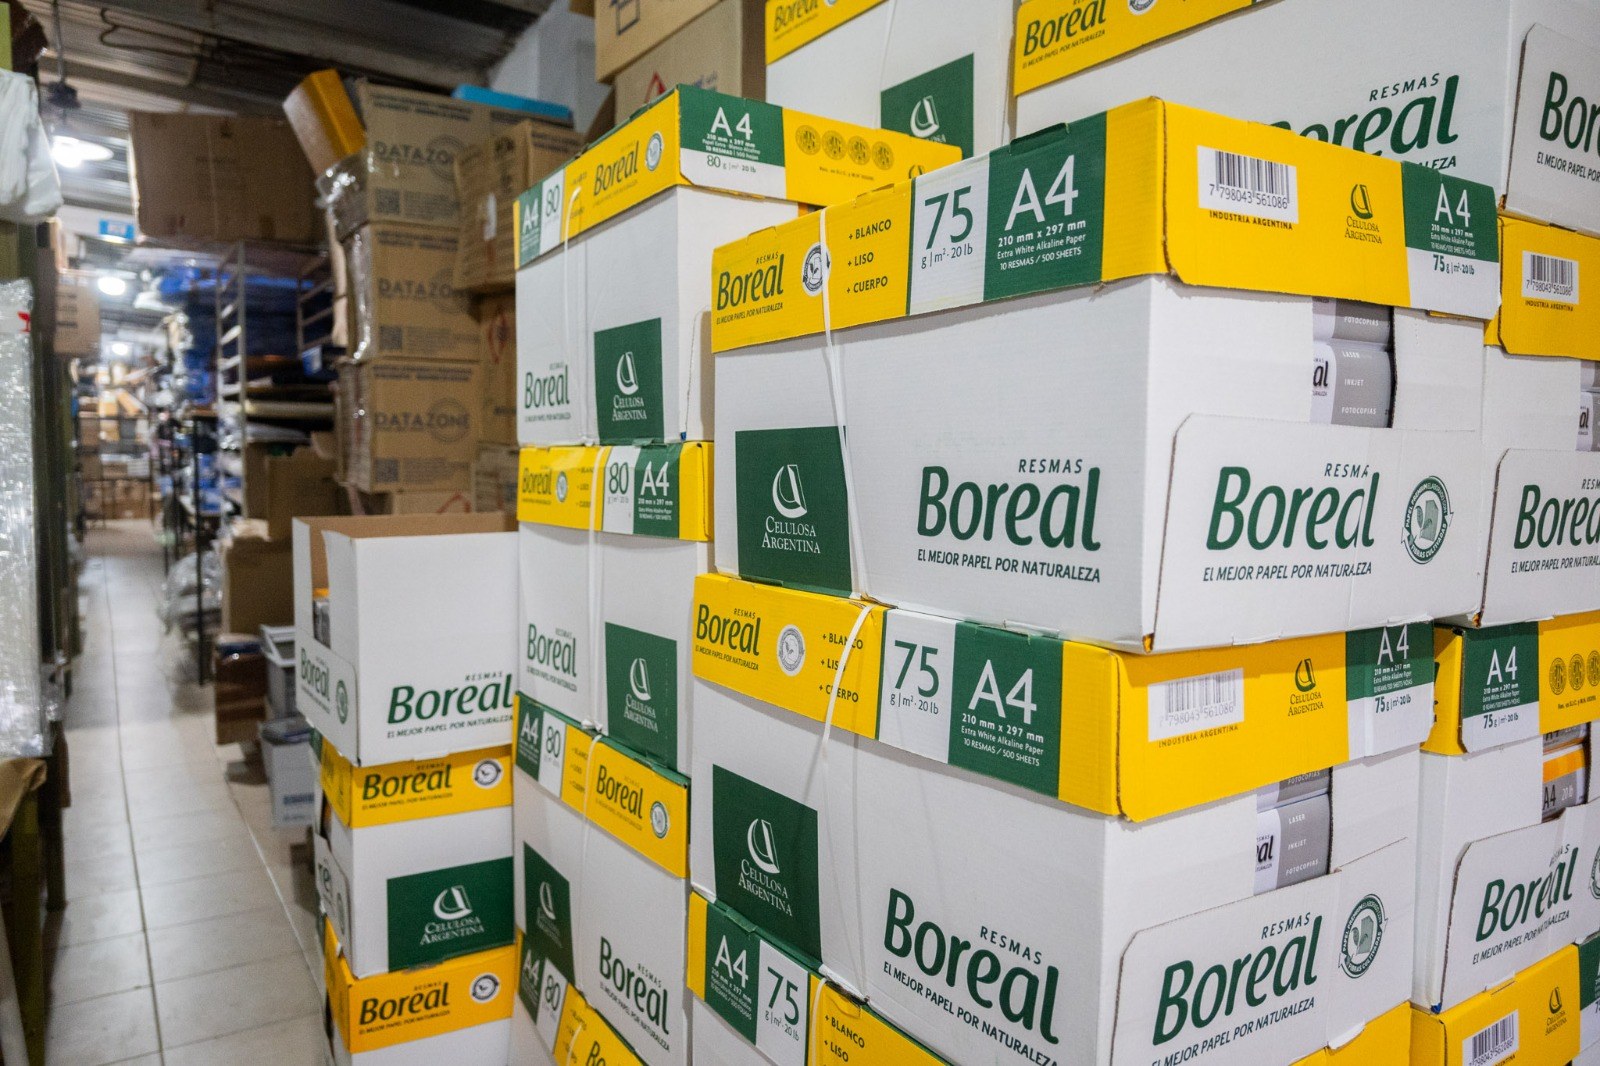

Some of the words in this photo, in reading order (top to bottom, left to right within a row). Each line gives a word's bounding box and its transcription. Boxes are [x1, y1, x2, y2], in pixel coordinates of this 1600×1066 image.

[1023, 0, 1106, 56] Boreal
[1369, 73, 1439, 101] RESMAS
[711, 107, 753, 140] A4
[1268, 75, 1459, 157] real
[1540, 71, 1600, 157] Bor
[594, 146, 639, 196] Boreal
[707, 155, 721, 167] 80
[1544, 154, 1567, 173] MEJOR
[1567, 162, 1586, 179] PAPEL
[1587, 169, 1600, 182] POR
[546, 185, 560, 217] 80
[1005, 154, 1079, 230] A4
[1220, 187, 1252, 204] 798043
[1256, 193, 1288, 209] 561086
[1434, 183, 1470, 227] A4
[523, 198, 539, 234] A4
[855, 219, 892, 241] BLANCO
[924, 185, 974, 250] 75
[1209, 210, 1250, 223] INDUSTRIA
[1253, 217, 1293, 230] ARGENTINA
[998, 235, 1013, 248] 210
[1017, 233, 1033, 243] mm
[1046, 223, 1063, 236] 297
[1067, 220, 1086, 231] mm
[998, 249, 1013, 260] Extra
[1015, 244, 1034, 255] White
[1037, 238, 1064, 251] Alkaline
[1065, 233, 1086, 245] Paper
[756, 251, 778, 264] RESMAS
[855, 252, 874, 267] LISO
[1000, 262, 1007, 271] 10
[1008, 257, 1034, 270] RESMAS
[1041, 252, 1055, 263] 500
[1055, 247, 1082, 261] SHEETS
[1433, 254, 1445, 272] 75
[717, 254, 784, 310] Boreal
[853, 276, 888, 293] CUERPO
[1344, 316, 1379, 327] FOTOCOPIAS
[525, 364, 570, 409] Boreal
[1344, 378, 1364, 387] INKJET
[1341, 406, 1377, 415] FOTOCOPIAS
[609, 462, 629, 494] 80
[641, 461, 669, 496] A4
[1018, 458, 1083, 473] RESMAS
[917, 465, 1101, 551] Boreal
[1206, 466, 1380, 550] Boreal
[765, 515, 816, 538] CELULOSA
[762, 532, 820, 554] ARGENTINA
[928, 550, 959, 567] MEJOR
[961, 555, 992, 571] PAPEL
[995, 558, 1018, 573] POR
[1021, 560, 1100, 583] NATURALEZA
[1216, 566, 1253, 581] MEJOR
[1255, 565, 1288, 580] PAPEL
[1291, 564, 1314, 579] POR
[1519, 560, 1540, 572] MEJOR
[1541, 559, 1559, 570] PAPEL
[1560, 558, 1574, 568] POR
[734, 608, 756, 619] RESMAS
[696, 604, 761, 656] Boreal
[1377, 624, 1409, 665] A4
[528, 623, 577, 677] Boreal
[712, 651, 723, 660] PAPEL
[724, 654, 732, 662] POR
[732, 657, 759, 671] NATURALEZA
[1487, 646, 1517, 685] A4
[301, 647, 330, 701] Boreal
[894, 640, 939, 698] 75
[388, 673, 513, 724] Boreal
[968, 659, 1037, 725] A4
[1375, 696, 1385, 713] 75
[397, 727, 423, 738] MEJOR
[425, 724, 448, 734] PAPEL
[450, 722, 465, 730] POR
[521, 712, 539, 744] A4
[962, 713, 976, 725] 210
[979, 719, 995, 729] mm
[1007, 725, 1023, 737] 297
[1027, 732, 1044, 743] mm
[1168, 710, 1200, 727] 798043
[1203, 703, 1234, 719] 561086
[1484, 714, 1492, 729] 75
[546, 726, 560, 758] 80
[961, 726, 976, 736] Extra
[978, 729, 996, 741] White
[998, 736, 1023, 749] Alkaline
[1025, 743, 1044, 755] Paper
[964, 738, 970, 746] 10
[971, 740, 996, 753] RESMAS
[1003, 749, 1015, 759] 500
[1016, 753, 1039, 766] SHEETS
[1159, 734, 1197, 748] INDUSTRIA
[1200, 725, 1239, 739] ARGENTINA
[363, 764, 452, 800] Boreal
[596, 765, 643, 820] Boreal
[1542, 784, 1556, 811] A4
[1288, 813, 1306, 825] LASER
[1287, 839, 1307, 850] INKJET
[741, 858, 788, 899] CELULOSA
[1285, 859, 1319, 876] FOTOCOPIAS
[738, 873, 793, 918] ARGENTINA
[1261, 912, 1311, 940] RESMAS
[980, 925, 1042, 965] RESMAS
[1480, 944, 1502, 961] MEJOR
[1504, 935, 1522, 951] PAPEL
[1523, 928, 1537, 941] POR
[715, 935, 748, 988] A4
[884, 888, 1059, 1045] Boreal
[545, 974, 560, 1011] 80
[600, 936, 669, 1035] Boreal
[767, 966, 799, 1026] 75
[1152, 915, 1323, 1046] Boreal
[359, 982, 449, 1025] Boreal
[893, 967, 923, 996] MEJOR
[925, 988, 954, 1015] PAPEL
[957, 1007, 979, 1029] POR
[981, 1020, 1060, 1066] NATURALEZA
[832, 1017, 864, 1048] BLANCO
[1200, 1030, 1230, 1054] PAPEL
[1233, 1021, 1253, 1040] POR
[1255, 996, 1315, 1031] NATURALEZA
[830, 1042, 848, 1062] LISO
